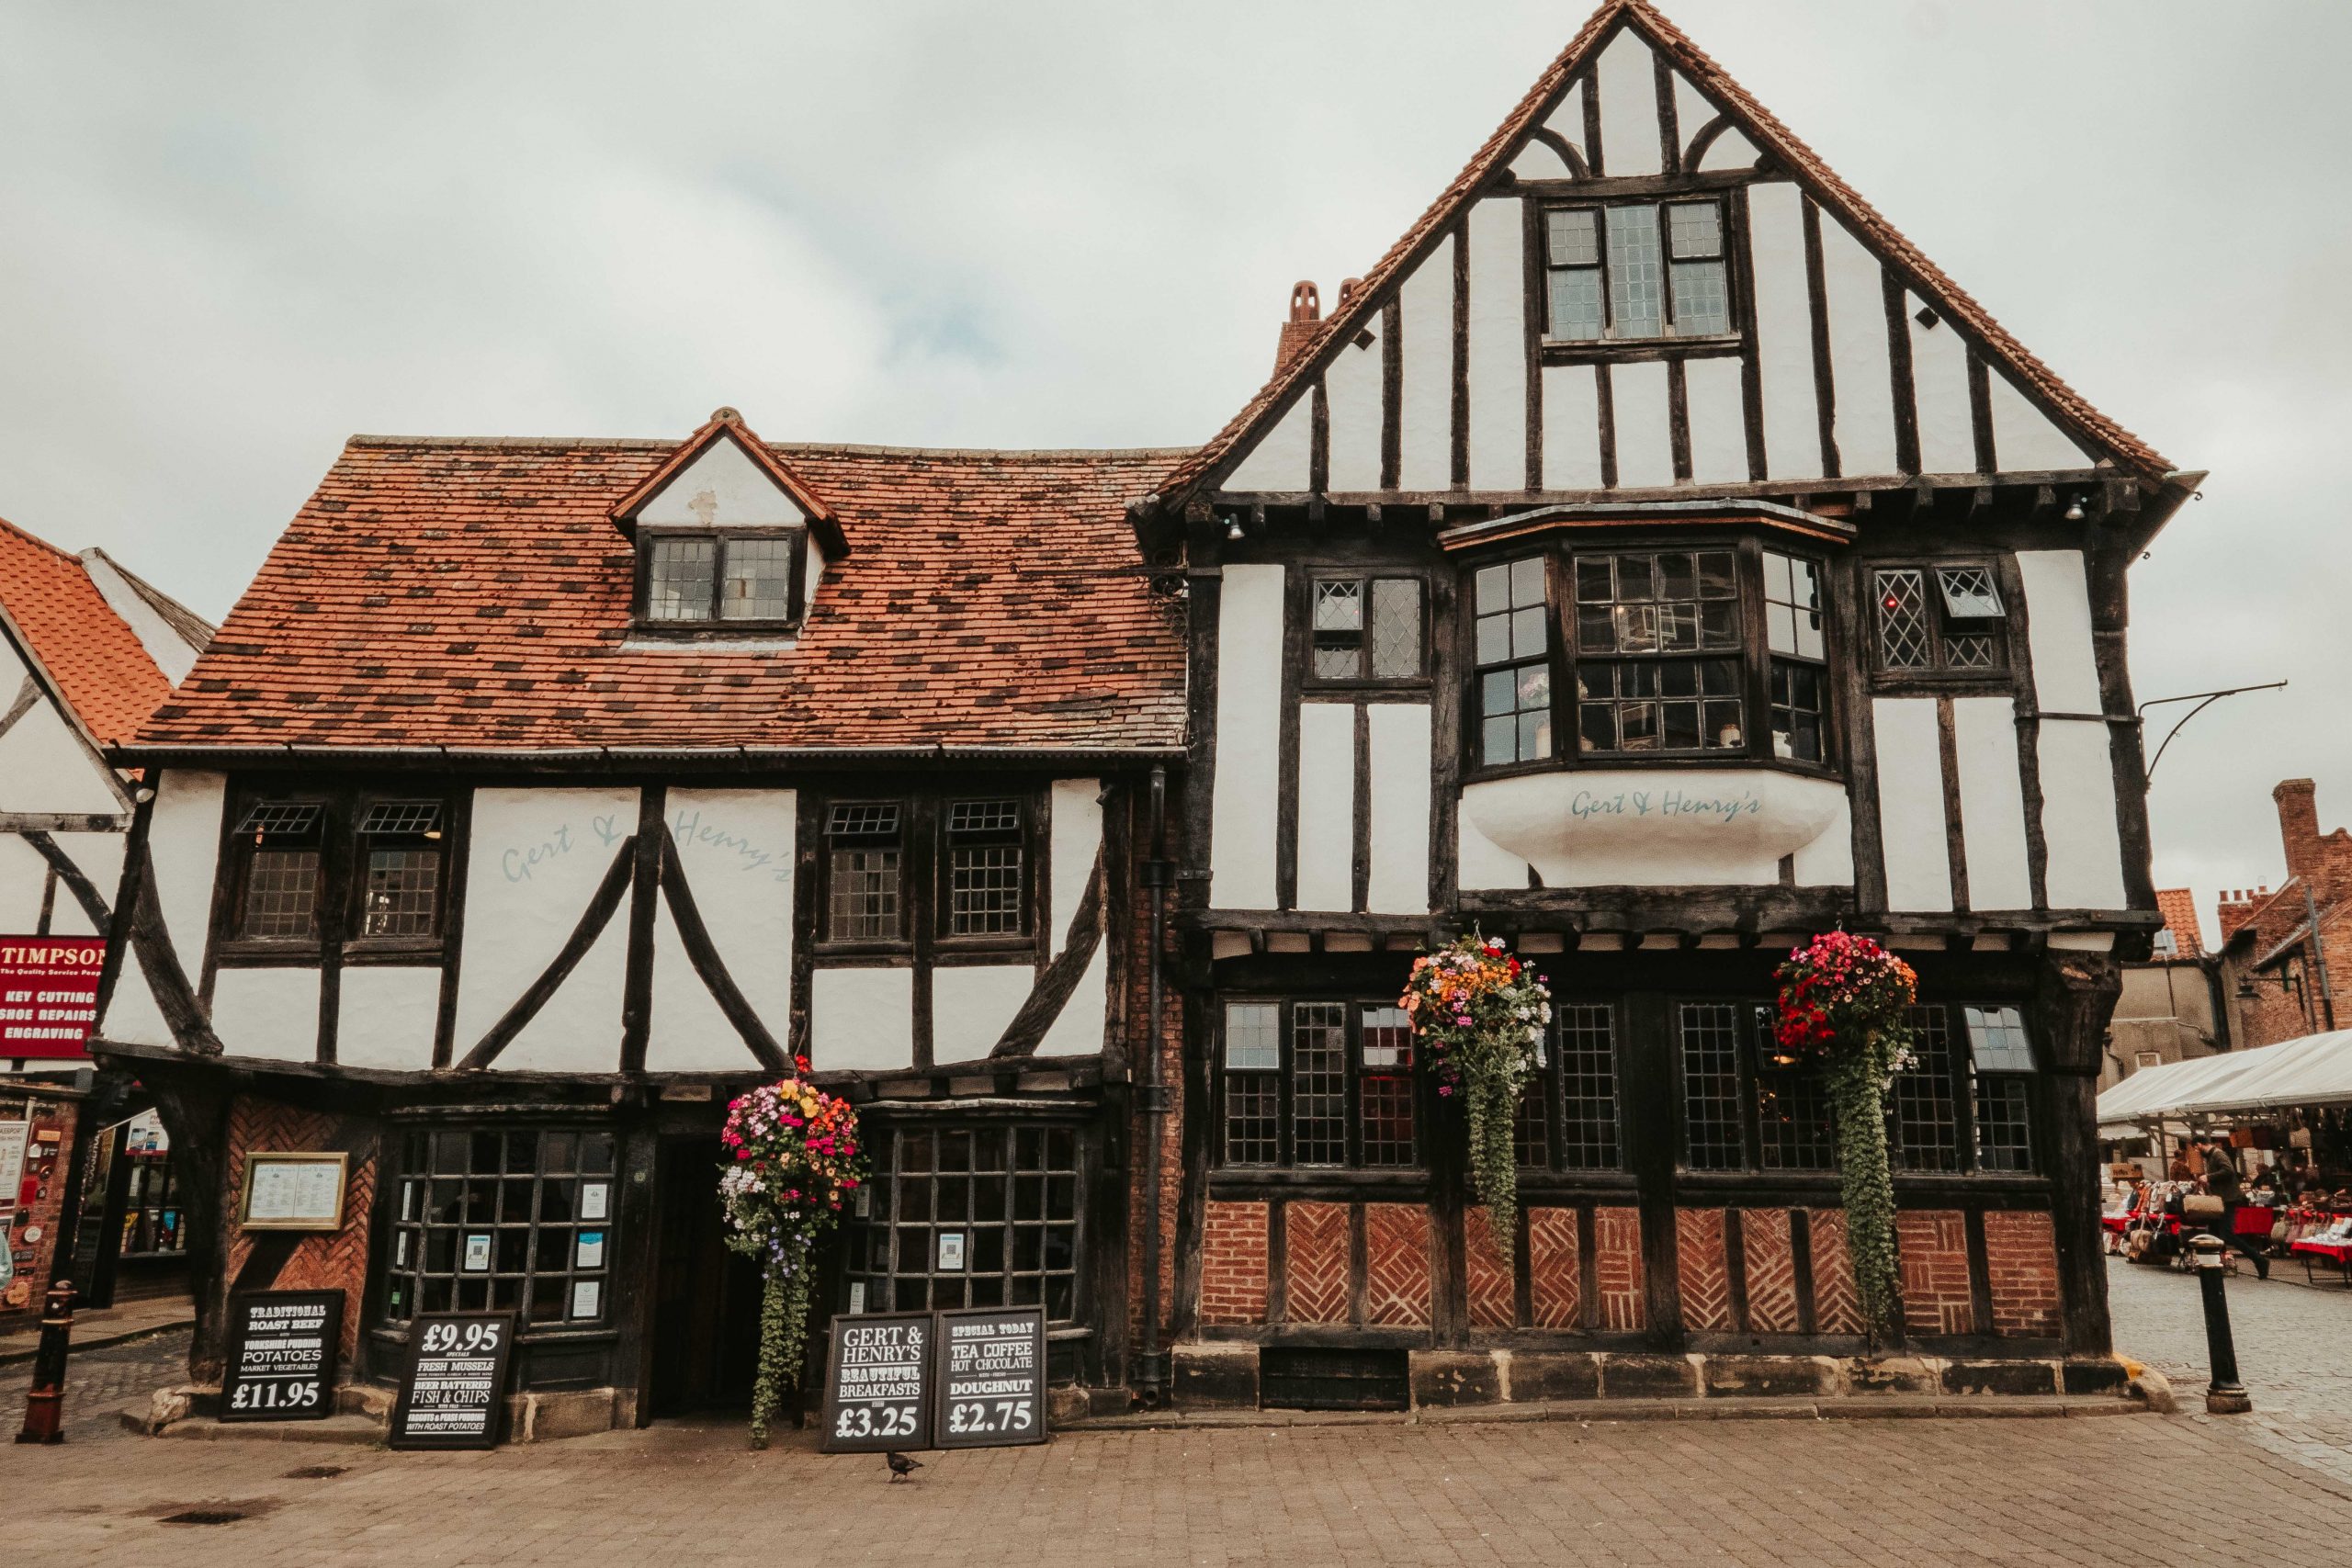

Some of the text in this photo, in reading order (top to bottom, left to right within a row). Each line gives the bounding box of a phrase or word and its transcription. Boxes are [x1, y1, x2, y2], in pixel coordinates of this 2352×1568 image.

[1572, 790, 1761, 822] Gert & Henry's
[502, 824, 575, 883] Gert
[593, 814, 622, 846] &
[6, 991, 95, 1003] KEY CUTTING
[0, 1009, 96, 1021] SHOE REPAIRS
[5, 1027, 84, 1040] ENGRAVING
[250, 1305, 326, 1318] TRADITIONAL
[248, 1319, 323, 1331] ROAST BEEF
[952, 1322, 1035, 1337] SPECIAL TODAY
[422, 1324, 501, 1352] £9.95
[843, 1325, 923, 1348] GERT &
[244, 1338, 322, 1350] YORKSHIRE PUDDING
[951, 1342, 1033, 1359] TEA COFFEE
[242, 1349, 322, 1362] POTATOES
[842, 1345, 921, 1363] HENRY'S
[241, 1363, 319, 1372] MARKET VEGETABLES
[417, 1361, 494, 1371] FRESH MUSSELS
[951, 1357, 1033, 1371] HOT CHOCOLATE
[840, 1366, 921, 1382] BEAUTIFUL
[413, 1381, 492, 1390] BEER BATTERED
[839, 1382, 921, 1398] BREAKFASTS
[950, 1380, 1033, 1395] DOUGHNUT
[232, 1382, 320, 1409] £11.95
[411, 1390, 491, 1404] FISH & CHIPS
[835, 1406, 918, 1438] £3.25
[949, 1401, 1032, 1433] £2.75
[448, 1422, 485, 1430] POTATOES
